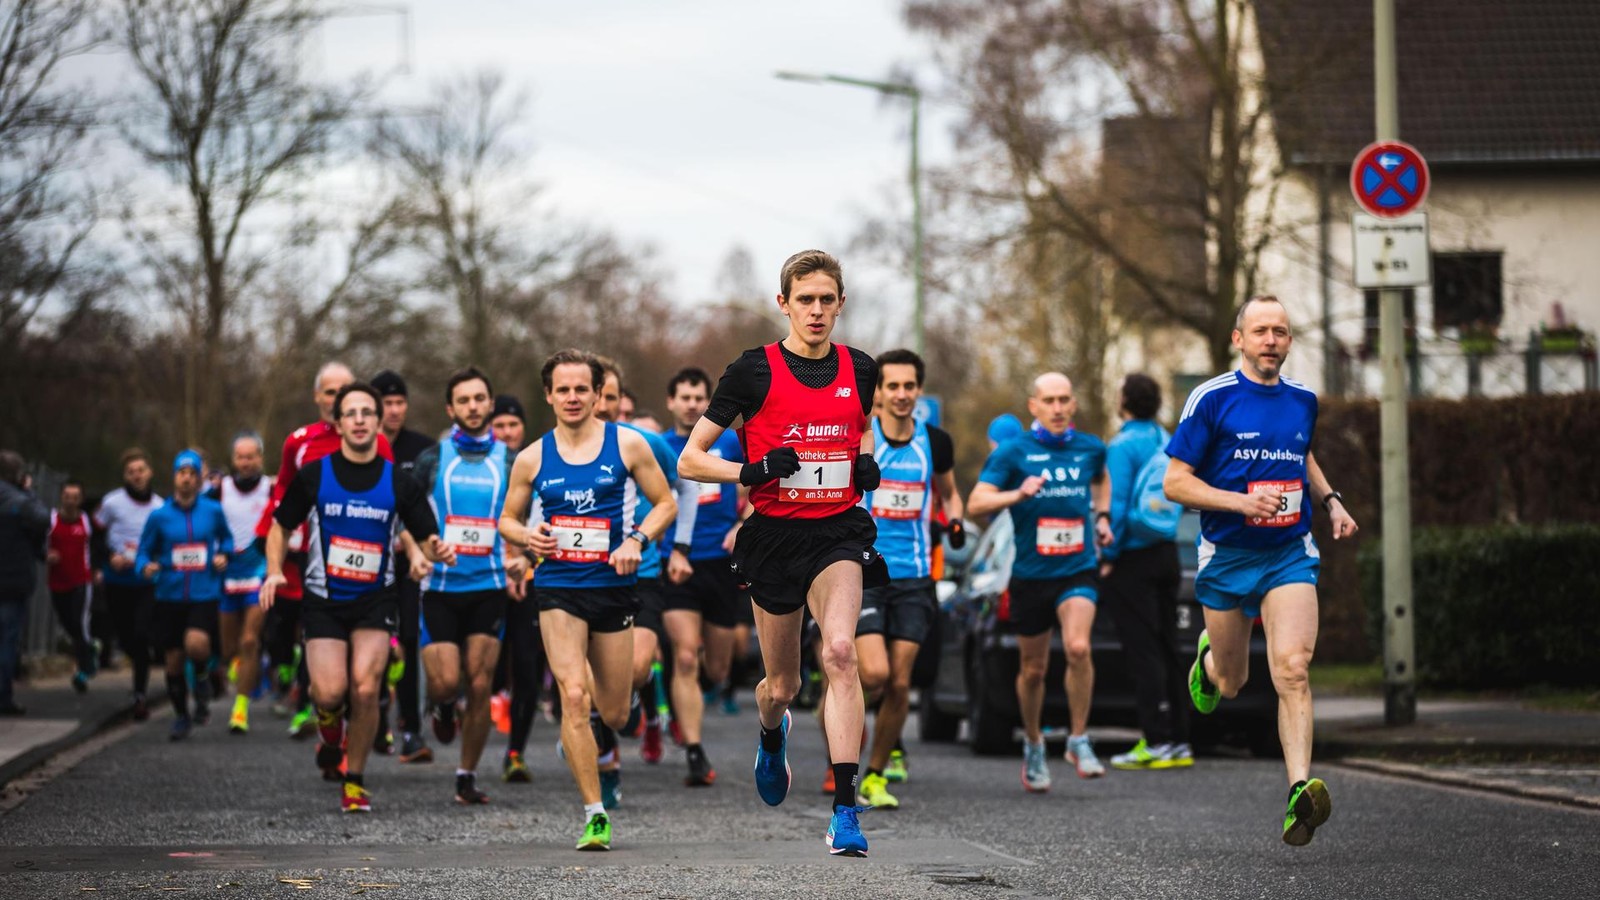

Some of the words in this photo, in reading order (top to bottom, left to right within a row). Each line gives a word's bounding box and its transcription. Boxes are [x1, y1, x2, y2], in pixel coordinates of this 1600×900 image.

[796, 451, 827, 460] otheke
[1234, 449, 1258, 459] ASV
[1261, 449, 1303, 465] Duisburg
[814, 466, 823, 486] 1
[1041, 467, 1081, 482] ASV
[816, 490, 825, 499] St.
[826, 490, 843, 499] Anna
[891, 494, 909, 507] 35
[325, 503, 343, 516] ASV
[462, 529, 480, 543] 50
[573, 532, 583, 547] 2
[1055, 532, 1072, 544] 45
[345, 553, 365, 569] 40
